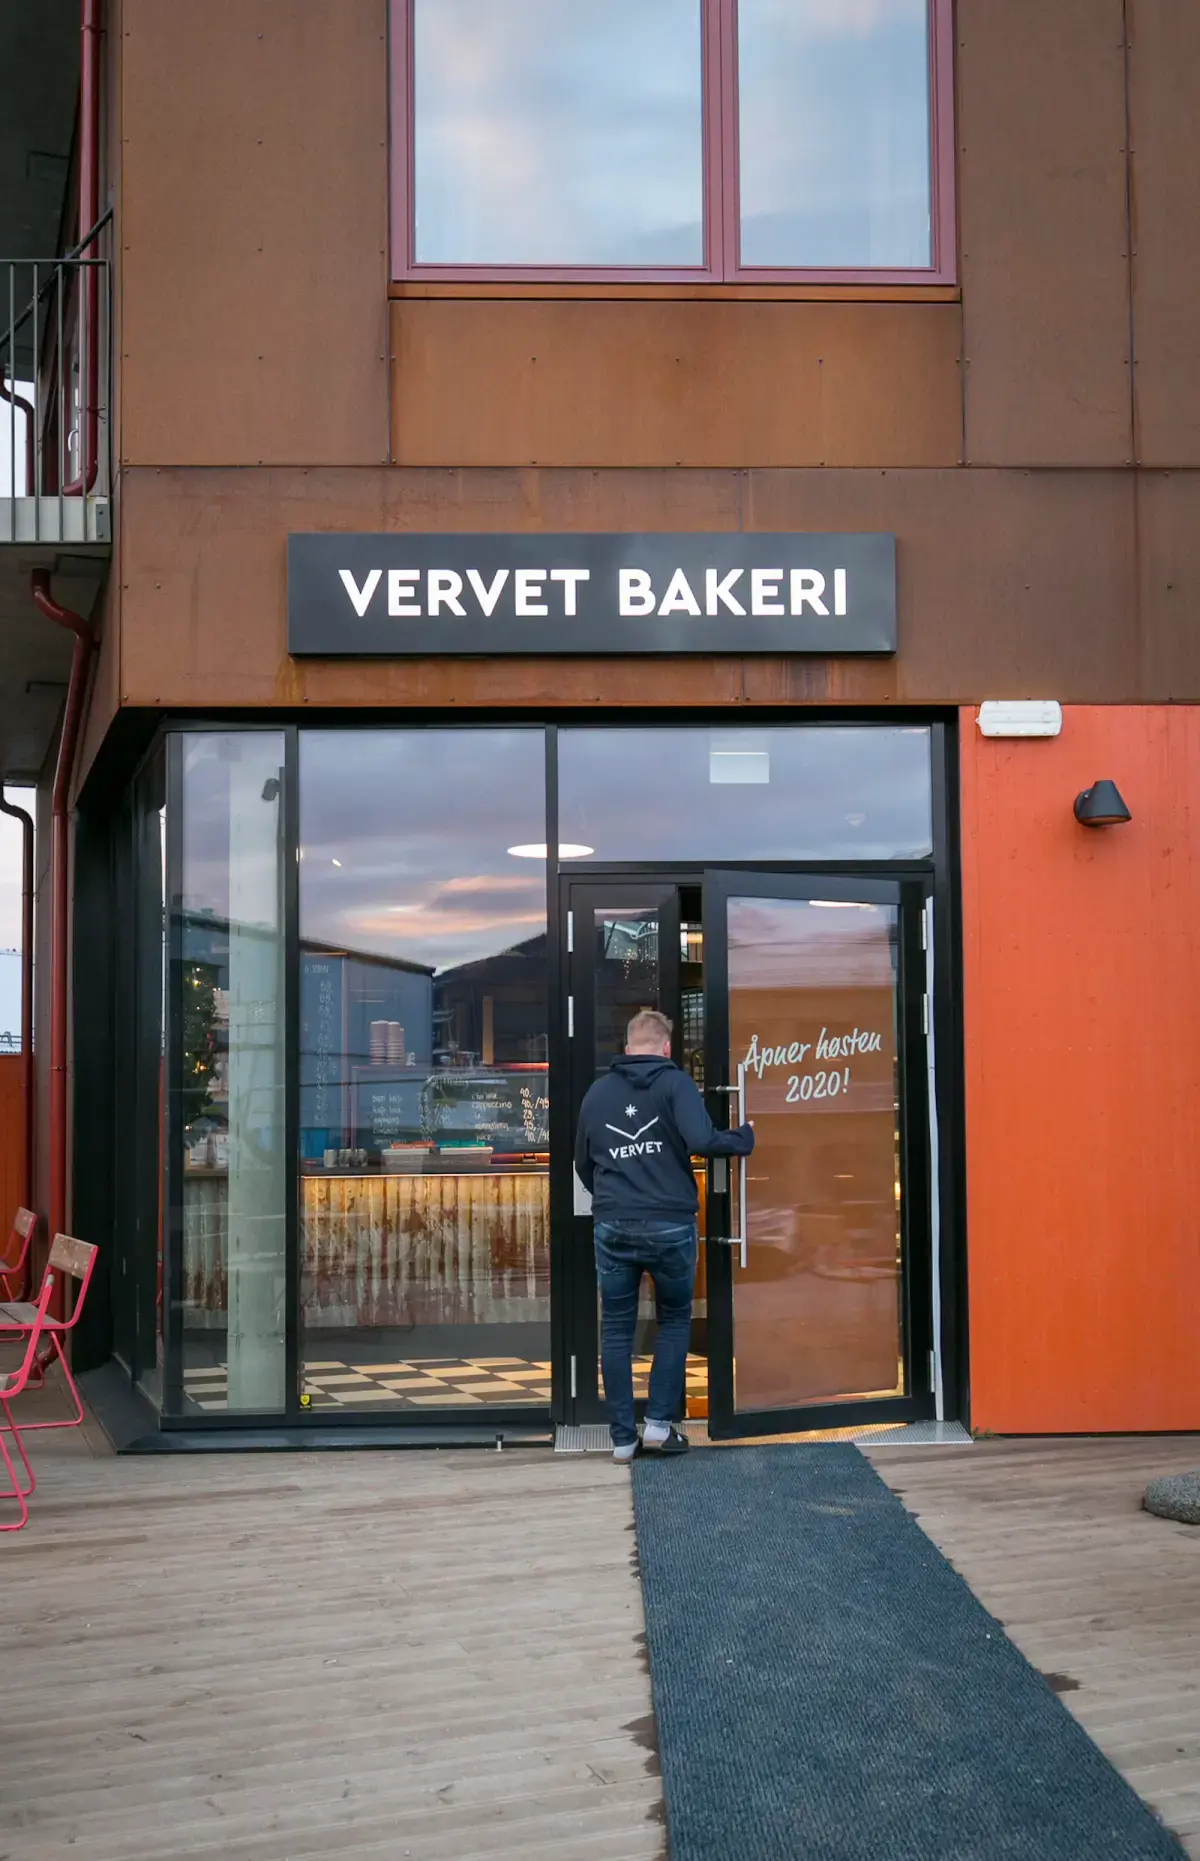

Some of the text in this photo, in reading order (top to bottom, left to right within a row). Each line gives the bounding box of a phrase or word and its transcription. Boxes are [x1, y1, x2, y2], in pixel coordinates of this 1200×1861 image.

[338, 567, 847, 617] VERVET BAKERI
[744, 1027, 882, 1079] Åpner høsten
[785, 1067, 850, 1103] 2020!
[608, 1141, 663, 1160] VERVET
